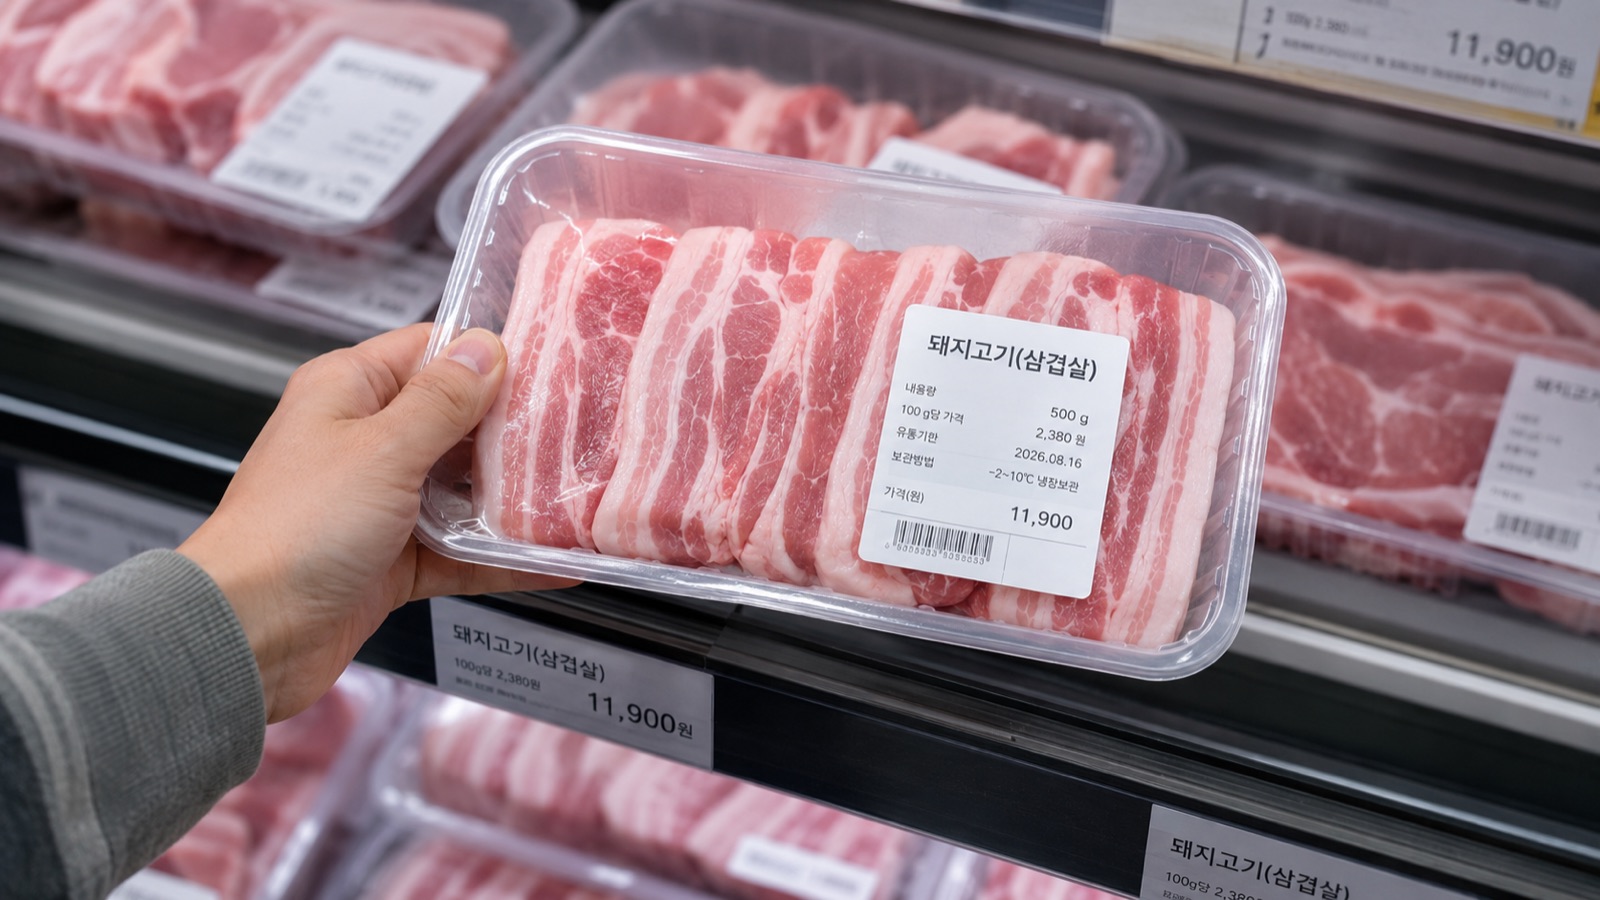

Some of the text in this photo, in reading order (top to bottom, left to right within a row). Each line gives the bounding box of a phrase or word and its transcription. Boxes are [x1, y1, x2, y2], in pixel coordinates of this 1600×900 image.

[927, 334, 1097, 382] 돼지고기(삼겹살)
[902, 404, 1086, 447] 100 g당 가격 2,380 원
[905, 382, 1089, 426] 내용량 500 g
[896, 426, 1082, 469] 유통기한 2026.08.16
[891, 451, 935, 468] 보관방법
[1037, 475, 1079, 493] 냉장보관
[884, 486, 1073, 530] 가격(원) 11,900
[453, 623, 606, 683] 돼지고기(삼겹살)
[455, 657, 492, 677] 100g당
[496, 669, 541, 691] 2,380원
[588, 692, 694, 740] 11,900원
[1166, 871, 1211, 894] 100g당
[1214, 886, 1263, 900] 2,38
[1170, 837, 1350, 900] 돼지고기(삼겹살)
